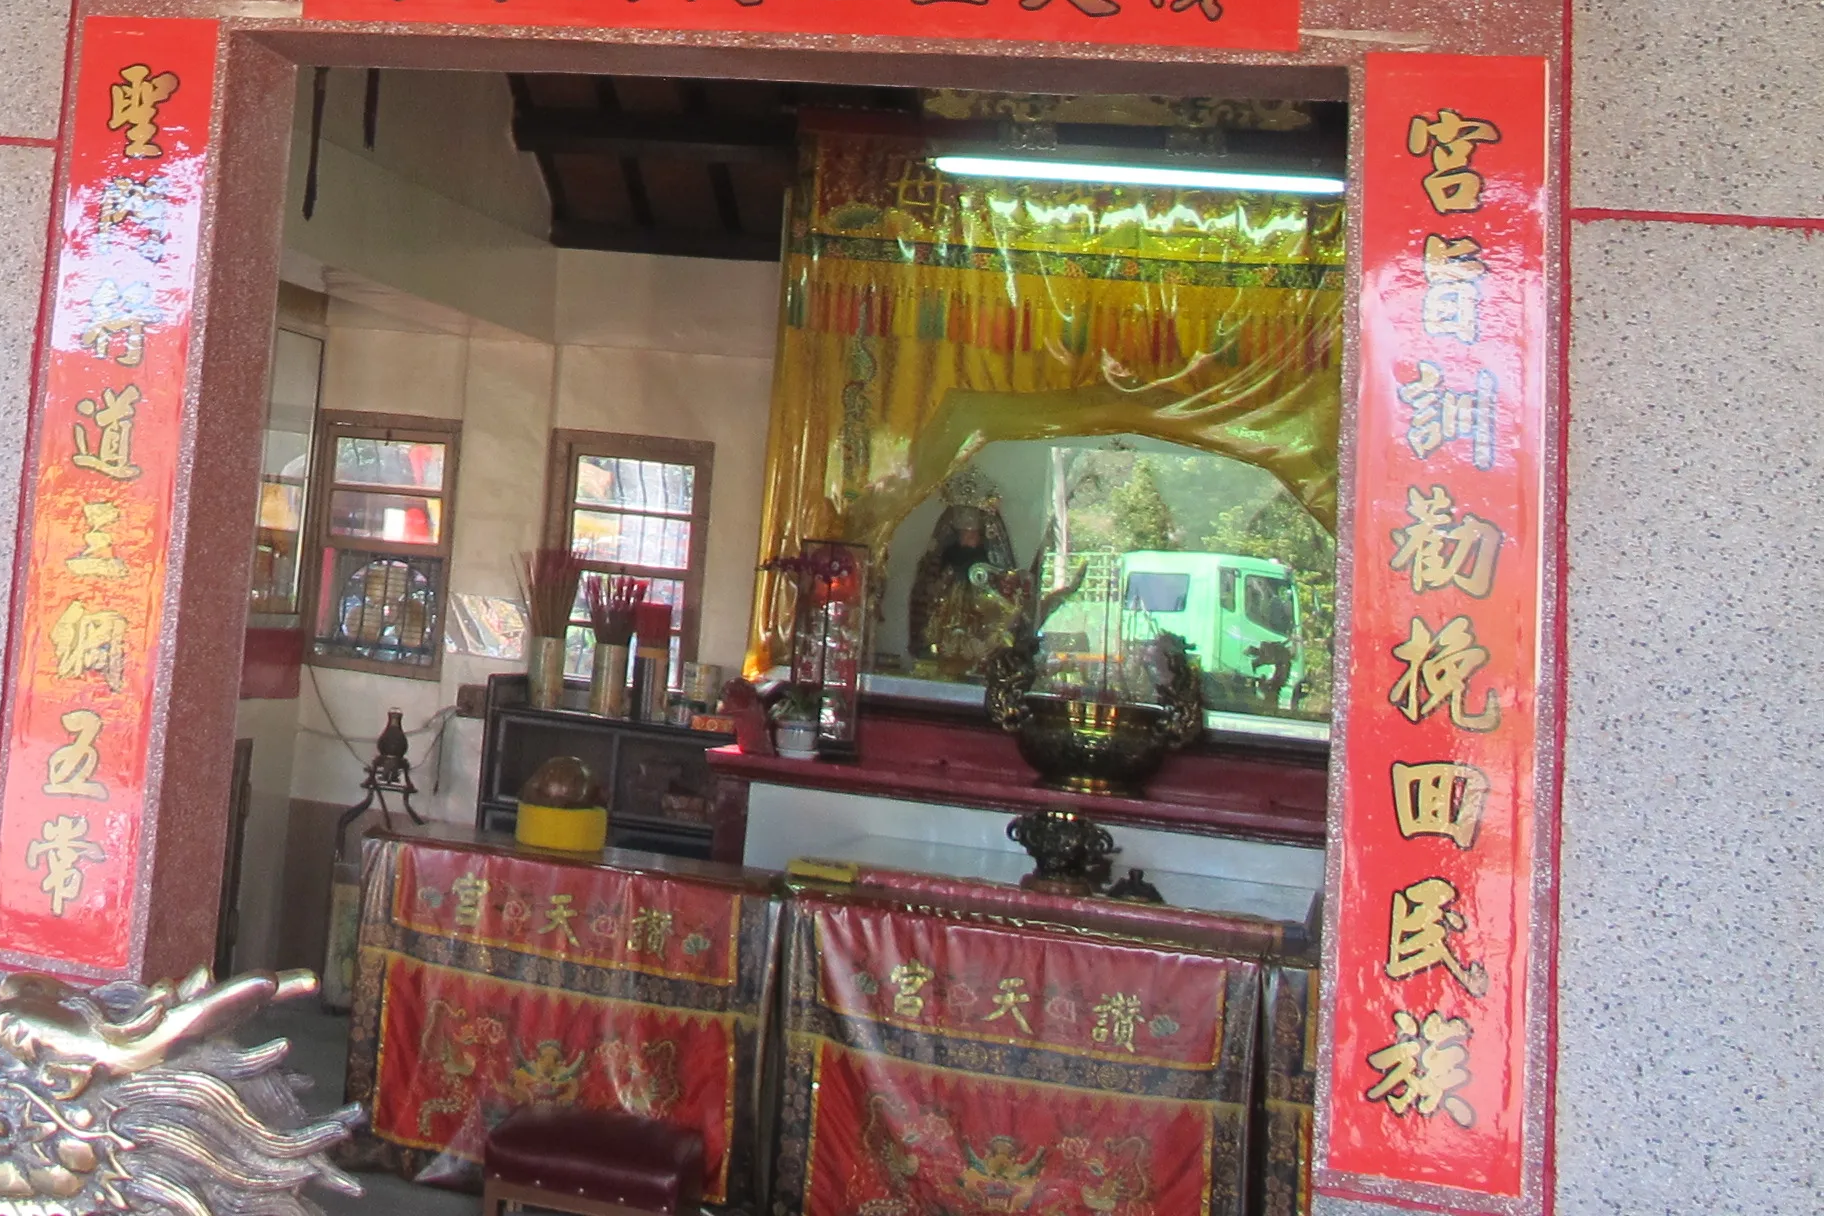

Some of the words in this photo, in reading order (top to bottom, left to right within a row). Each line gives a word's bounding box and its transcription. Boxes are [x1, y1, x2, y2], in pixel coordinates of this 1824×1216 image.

[451, 871, 675, 962] 讚天宮
[888, 958, 1146, 1054] 讚天宮
